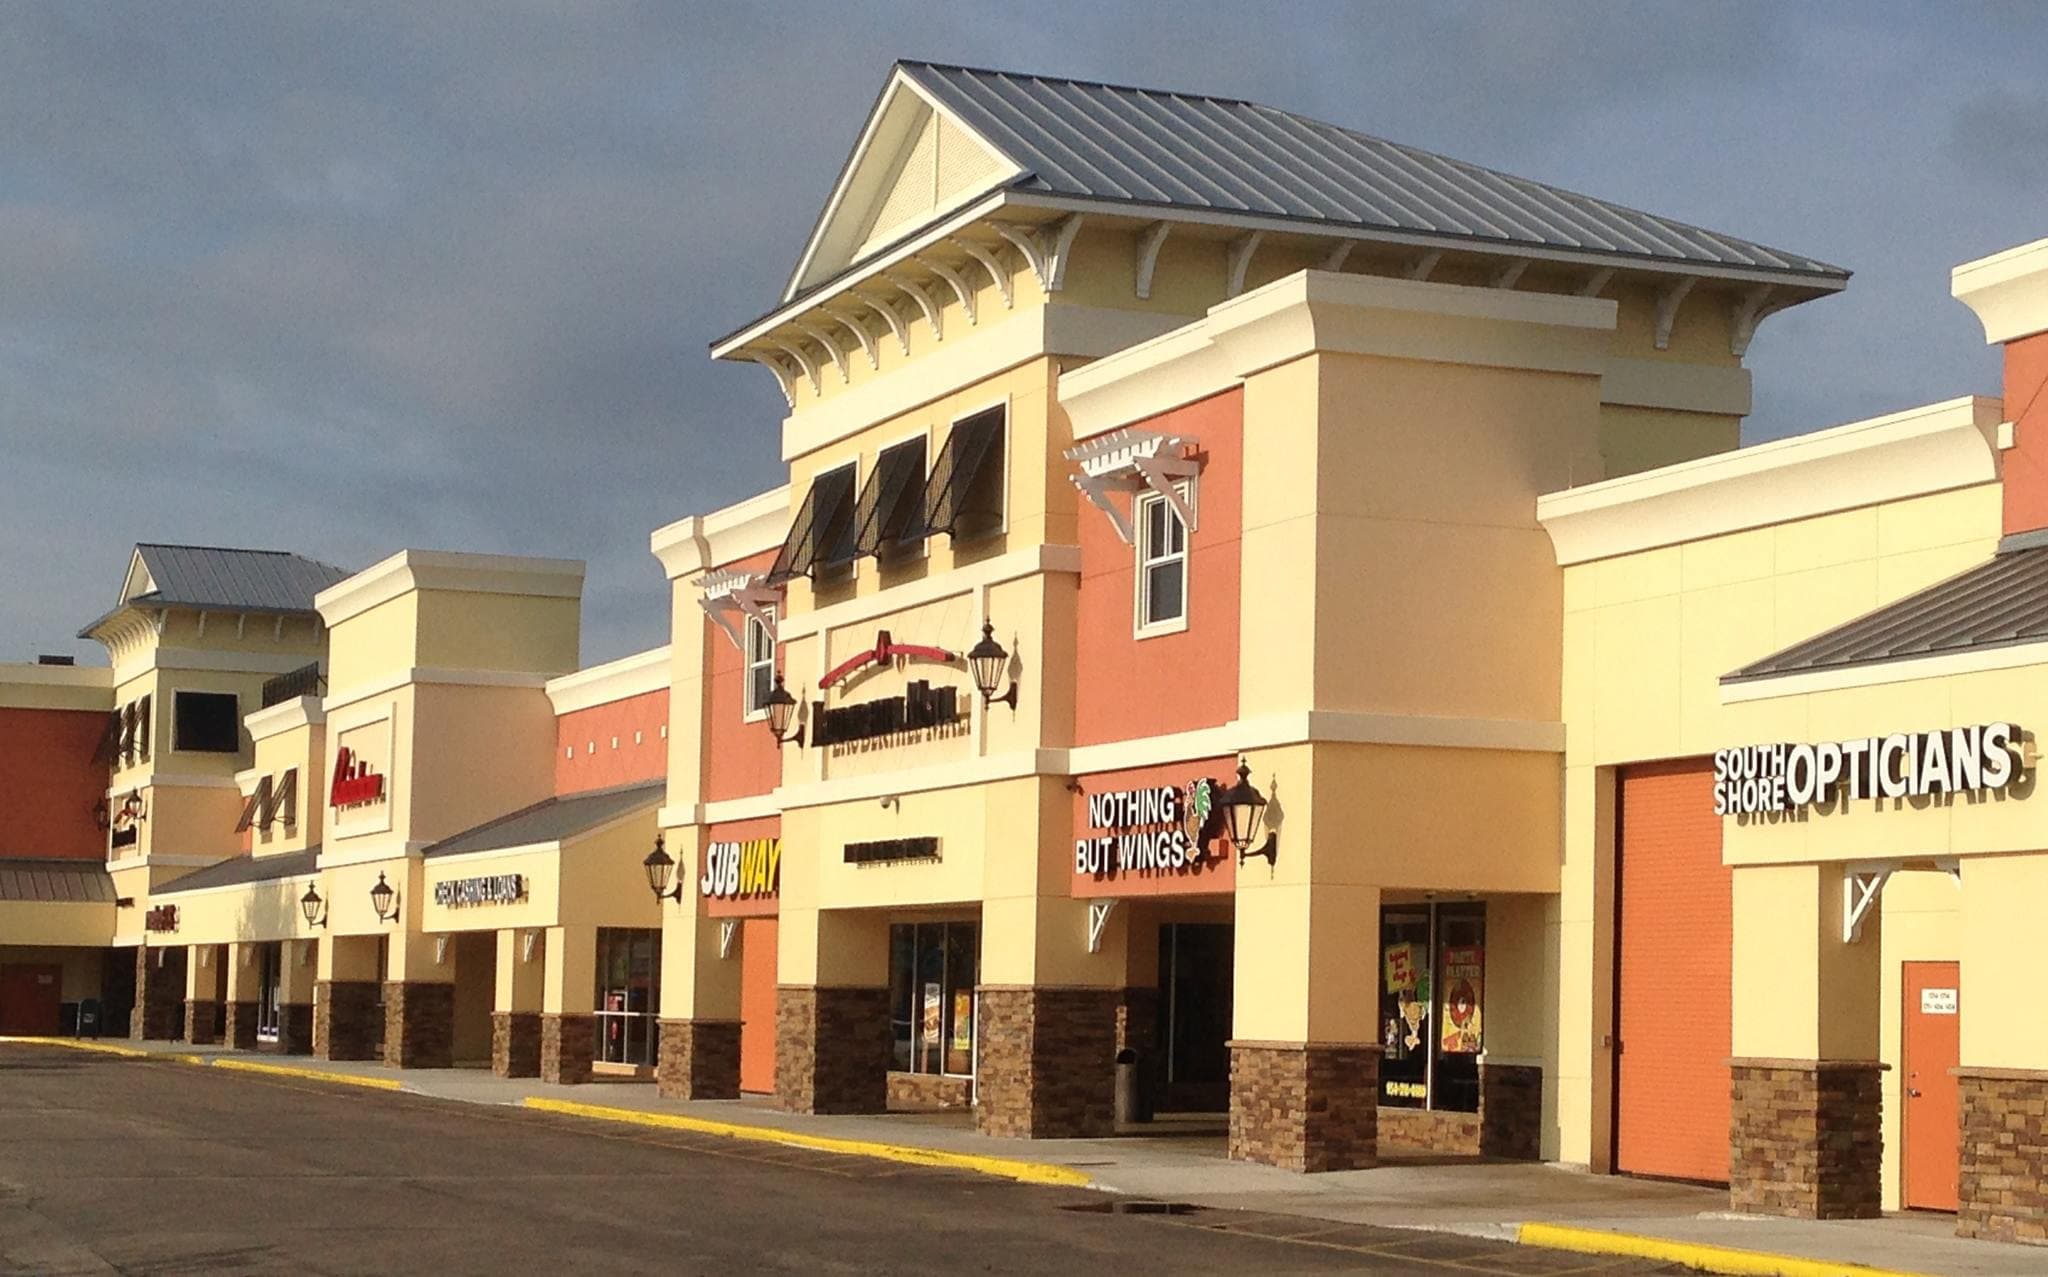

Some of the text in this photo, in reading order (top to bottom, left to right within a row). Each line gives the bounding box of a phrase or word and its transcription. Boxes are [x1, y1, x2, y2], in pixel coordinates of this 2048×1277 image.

[1713, 743, 1785, 782] SOUTH
[1786, 721, 2012, 805] OPTICIANS
[1089, 786, 1175, 829] NOTHING
[1713, 775, 1785, 816] SHORE
[701, 837, 784, 896] SUBWAY
[1075, 830, 1184, 874] BUT WINGS
